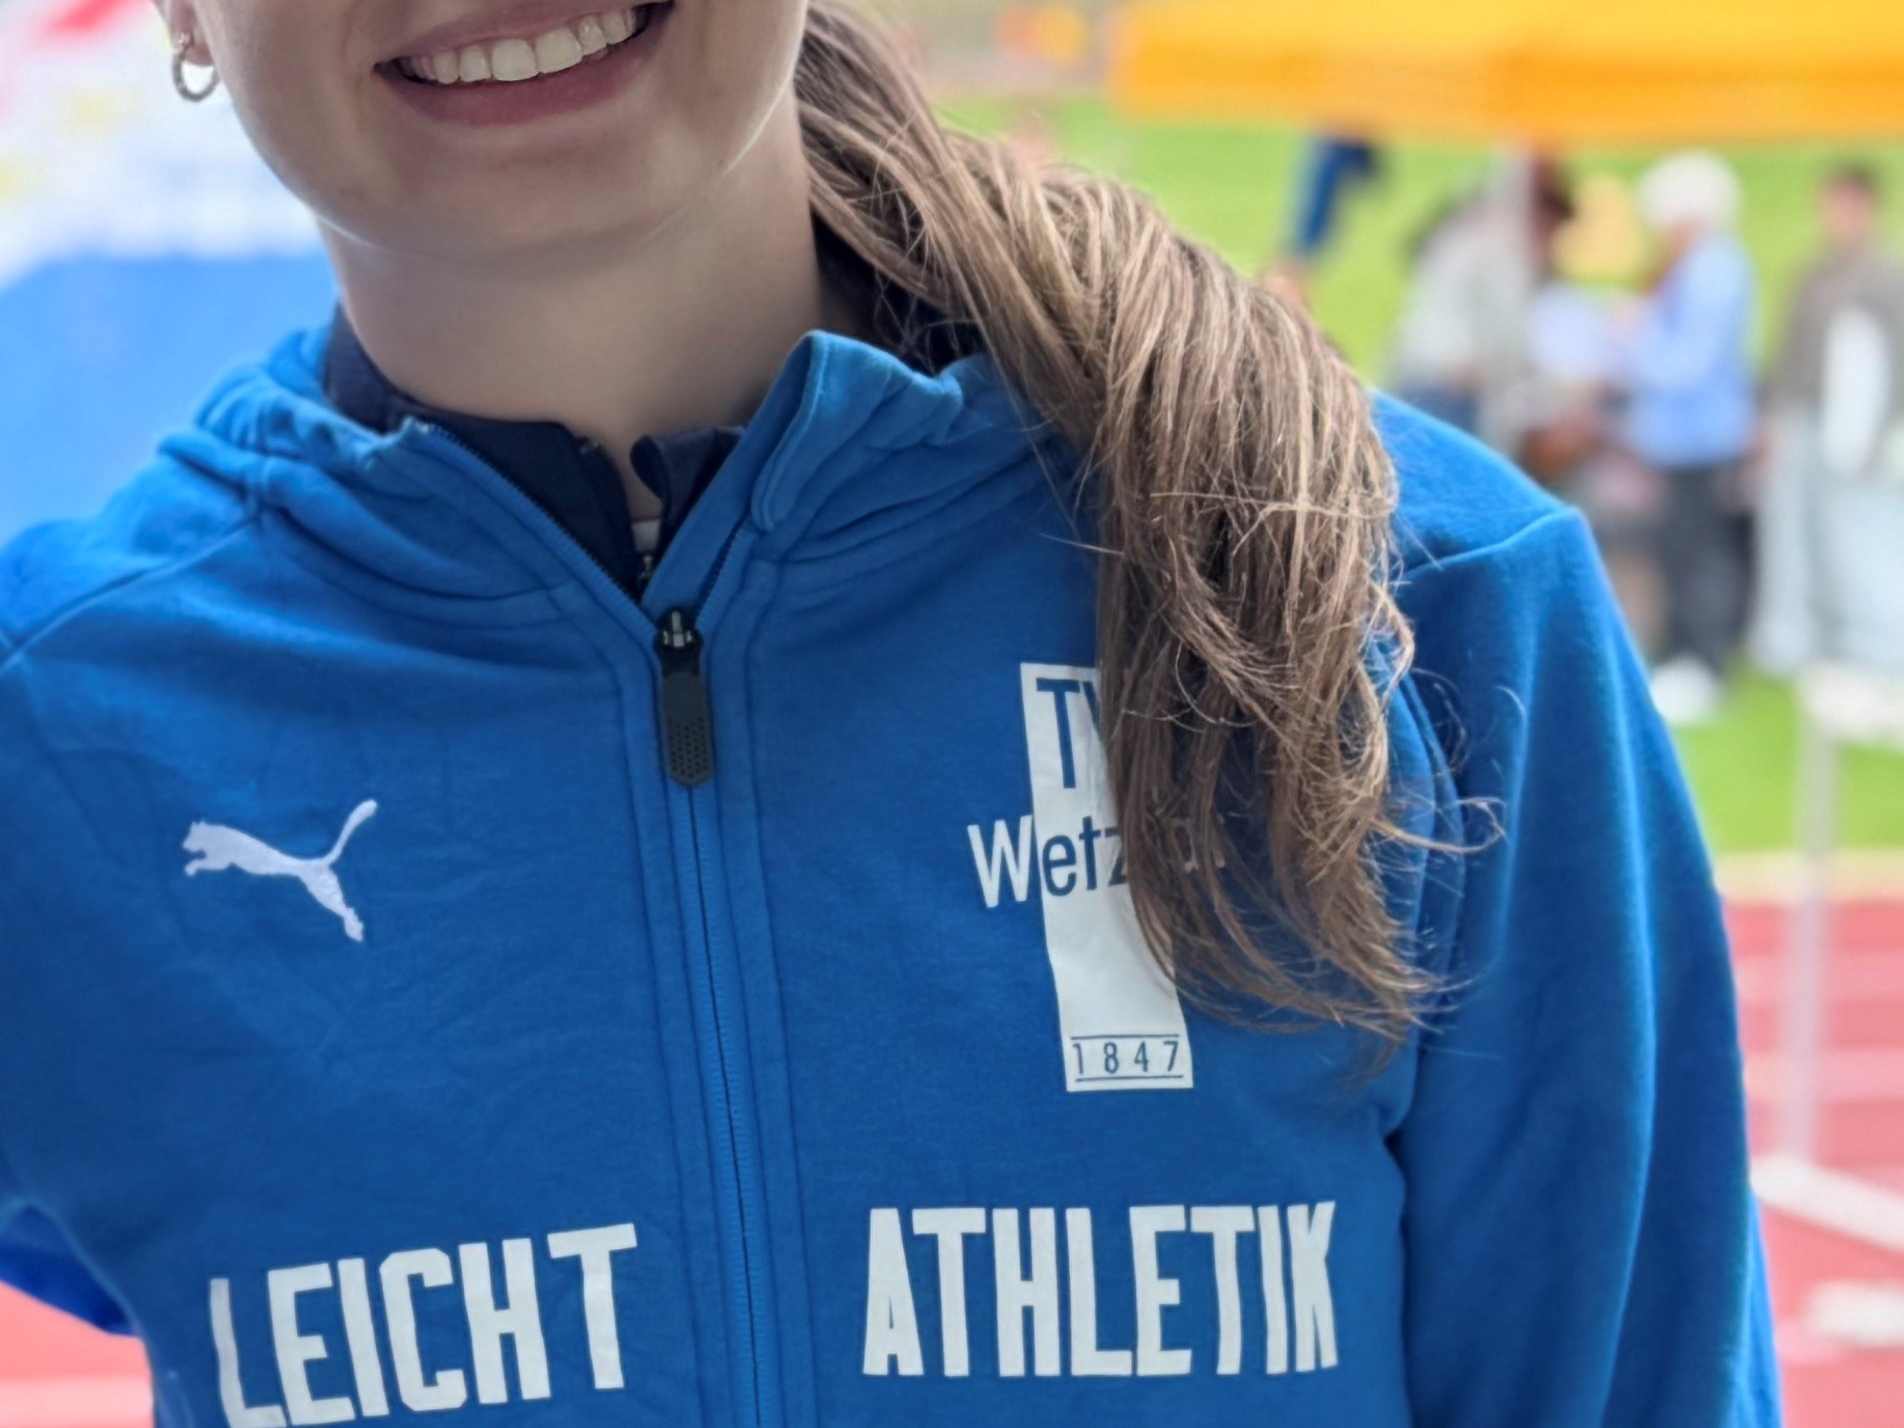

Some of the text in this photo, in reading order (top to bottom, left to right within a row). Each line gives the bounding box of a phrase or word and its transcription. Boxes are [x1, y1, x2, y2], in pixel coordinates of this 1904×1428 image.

[967, 815, 1130, 908] Wetz
[1072, 1041, 1180, 1075] 1847
[863, 1201, 1338, 1376] ATHLETIK
